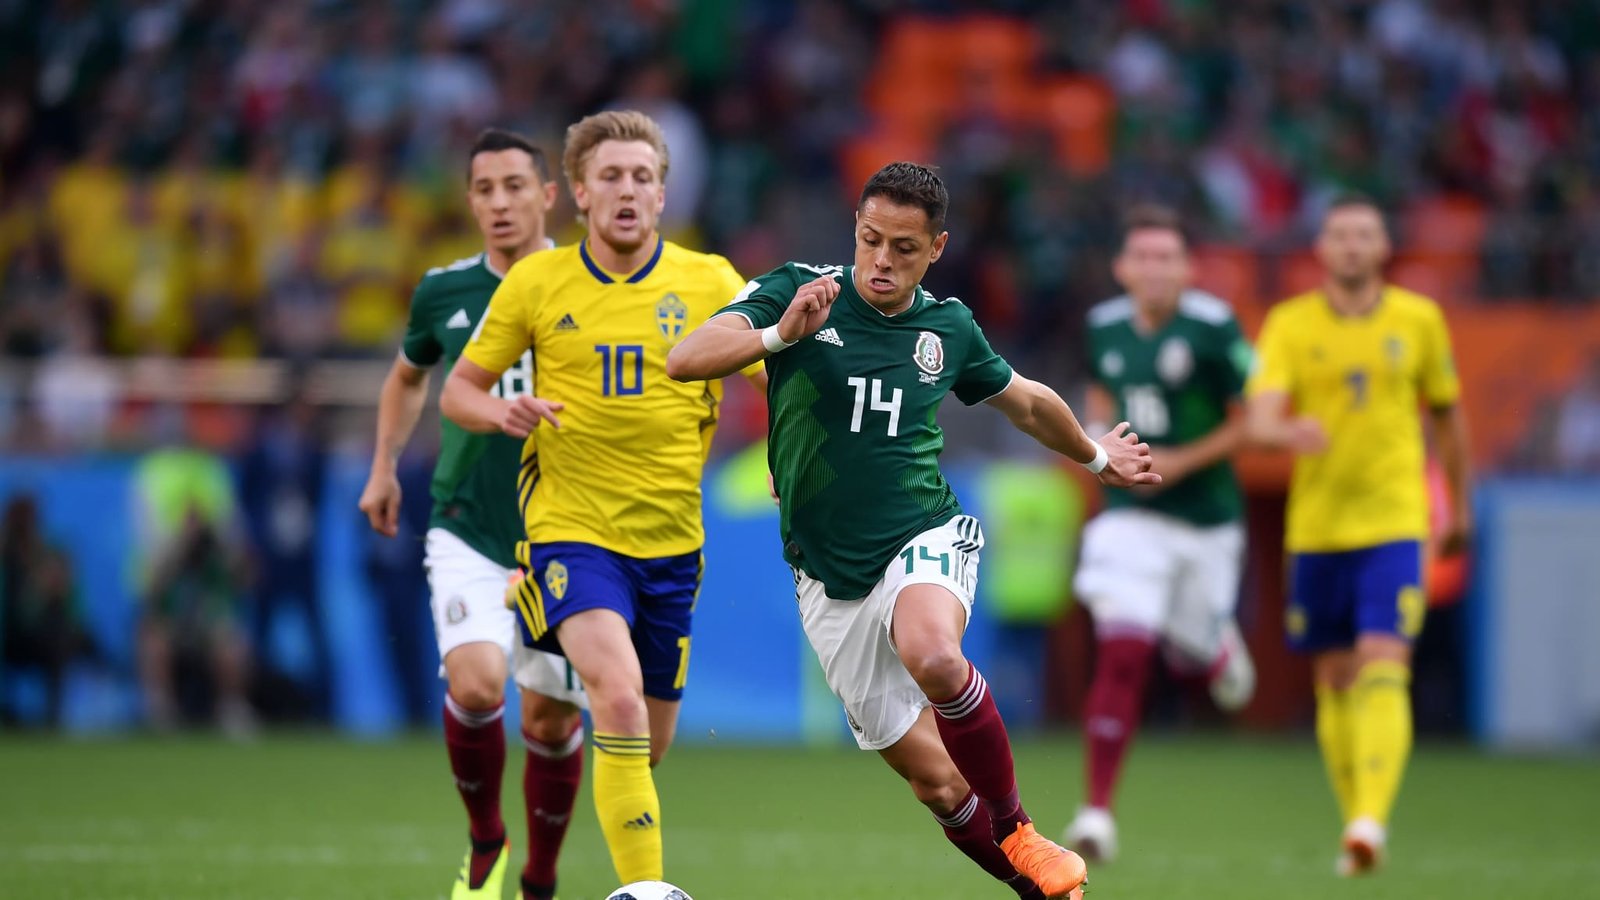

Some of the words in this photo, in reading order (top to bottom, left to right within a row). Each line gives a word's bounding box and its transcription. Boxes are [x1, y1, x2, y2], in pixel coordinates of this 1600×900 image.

[594, 345, 643, 396] 10
[848, 376, 903, 437] 14
[900, 544, 950, 577] 14
